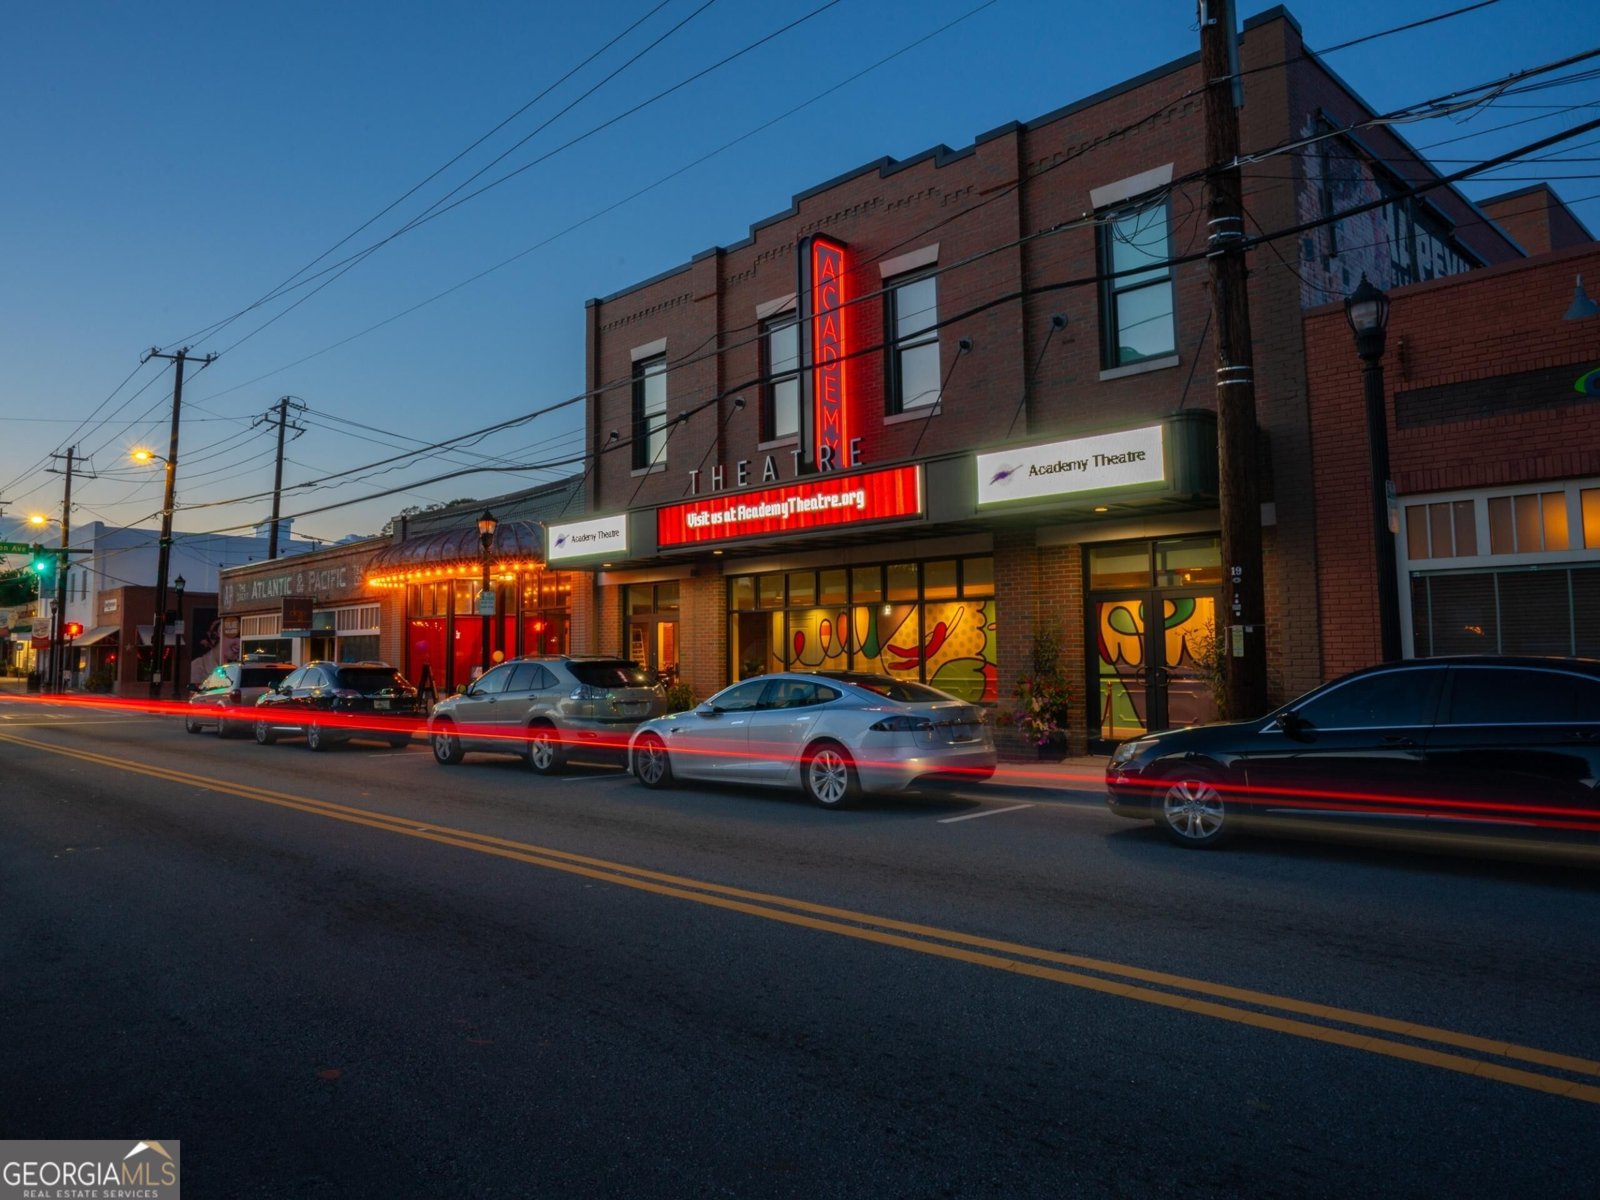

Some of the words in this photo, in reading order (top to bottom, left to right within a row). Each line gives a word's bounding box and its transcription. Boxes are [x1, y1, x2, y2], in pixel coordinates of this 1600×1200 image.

[689, 437, 863, 495] THEATRE
[1028, 458, 1089, 477] Academy
[1092, 450, 1147, 468] Theatre
[686, 510, 711, 528] Visit
[710, 511, 723, 525] us
[723, 507, 737, 523] at
[737, 490, 866, 521] AcademyTheatre.org
[571, 532, 597, 544] Academy
[597, 529, 620, 540] Theatre
[251, 576, 293, 599] ATLANTIC
[296, 572, 305, 593] &
[308, 567, 347, 592] PACIFIC
[1231, 566, 1242, 576] 19
